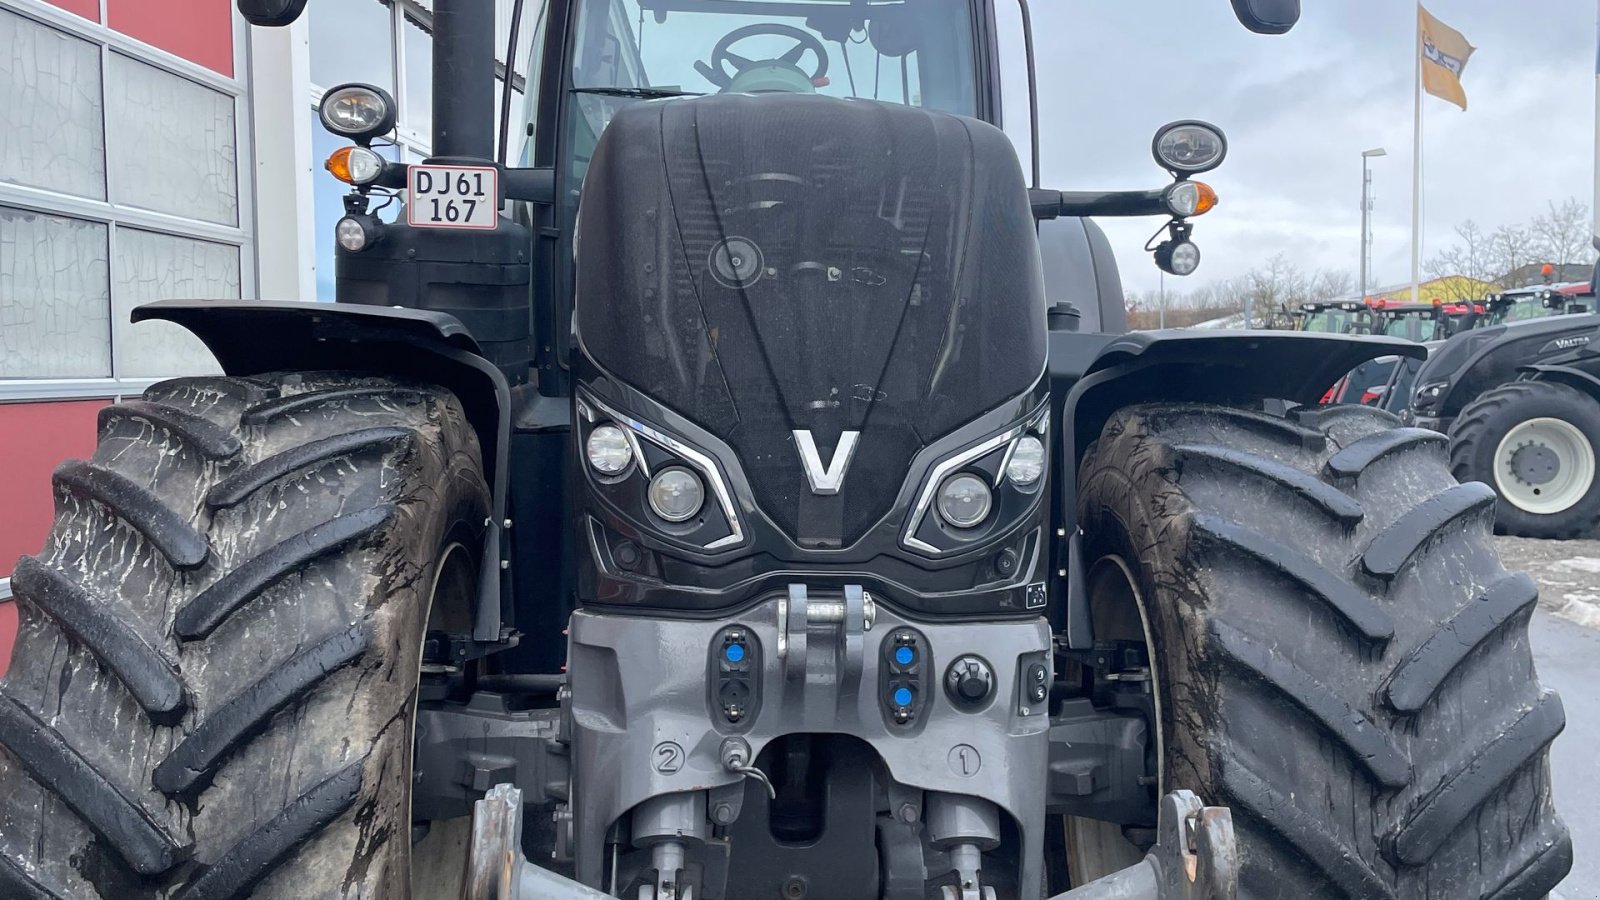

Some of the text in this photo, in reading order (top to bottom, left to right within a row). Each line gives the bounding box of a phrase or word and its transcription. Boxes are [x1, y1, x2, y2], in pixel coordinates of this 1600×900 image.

[416, 171, 485, 196] DJ61
[430, 198, 477, 222] 167
[658, 745, 678, 772] 2
